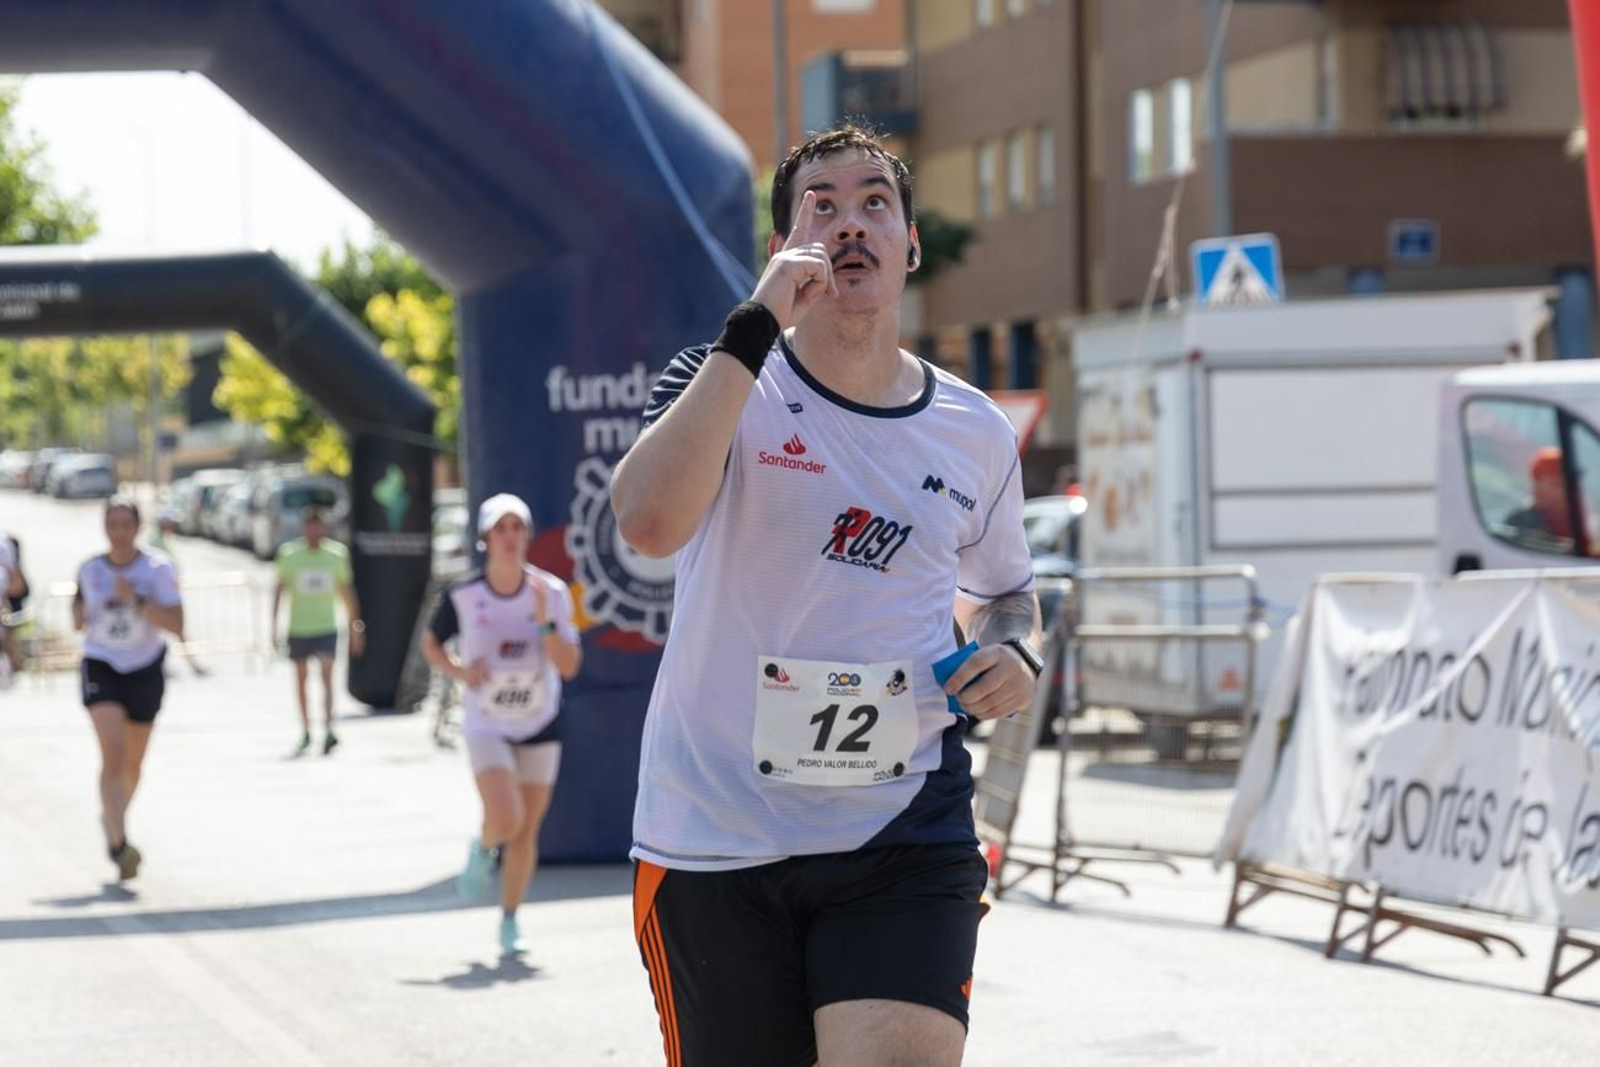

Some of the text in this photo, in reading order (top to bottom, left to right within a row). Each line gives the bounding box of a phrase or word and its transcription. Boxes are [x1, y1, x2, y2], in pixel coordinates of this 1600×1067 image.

[758, 451, 827, 474] Santander
[949, 488, 977, 512] mupol
[809, 703, 879, 752] 12
[797, 758, 877, 769] PEDRO VALOR BELLIDO
